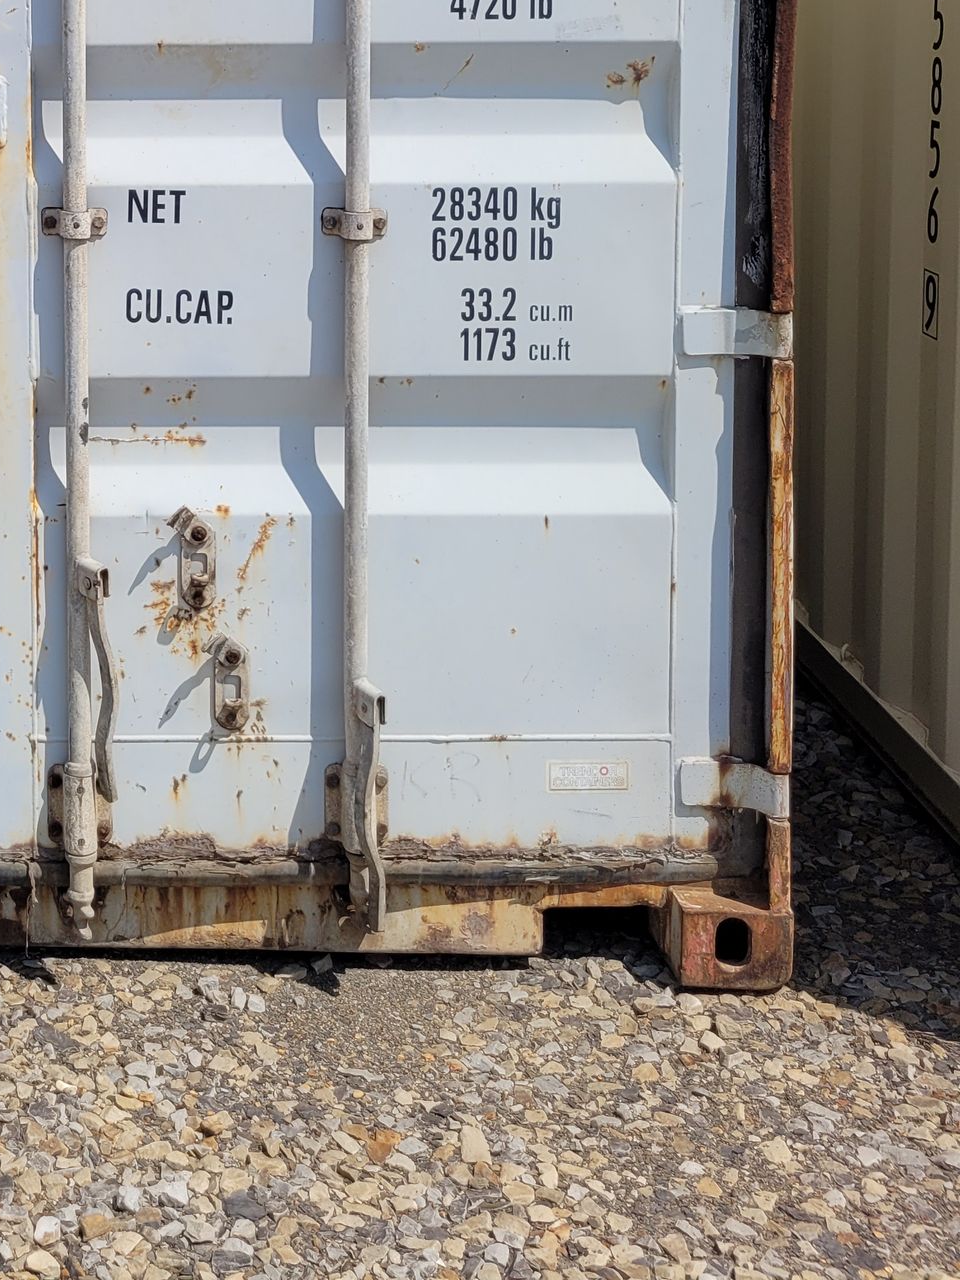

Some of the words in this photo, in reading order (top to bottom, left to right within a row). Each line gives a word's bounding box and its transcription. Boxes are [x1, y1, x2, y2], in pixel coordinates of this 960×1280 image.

[127, 189, 186, 224] NET
[431, 186, 518, 222] 28340
[530, 187, 561, 230] kg
[431, 226, 518, 262] 62480
[530, 227, 553, 261] lb
[125, 288, 234, 325] CU.CAP.
[460, 287, 517, 322] 33.2
[528, 303, 573, 322] cu.m
[460, 327, 516, 362] 1173
[528, 337, 571, 361] cu.ft
